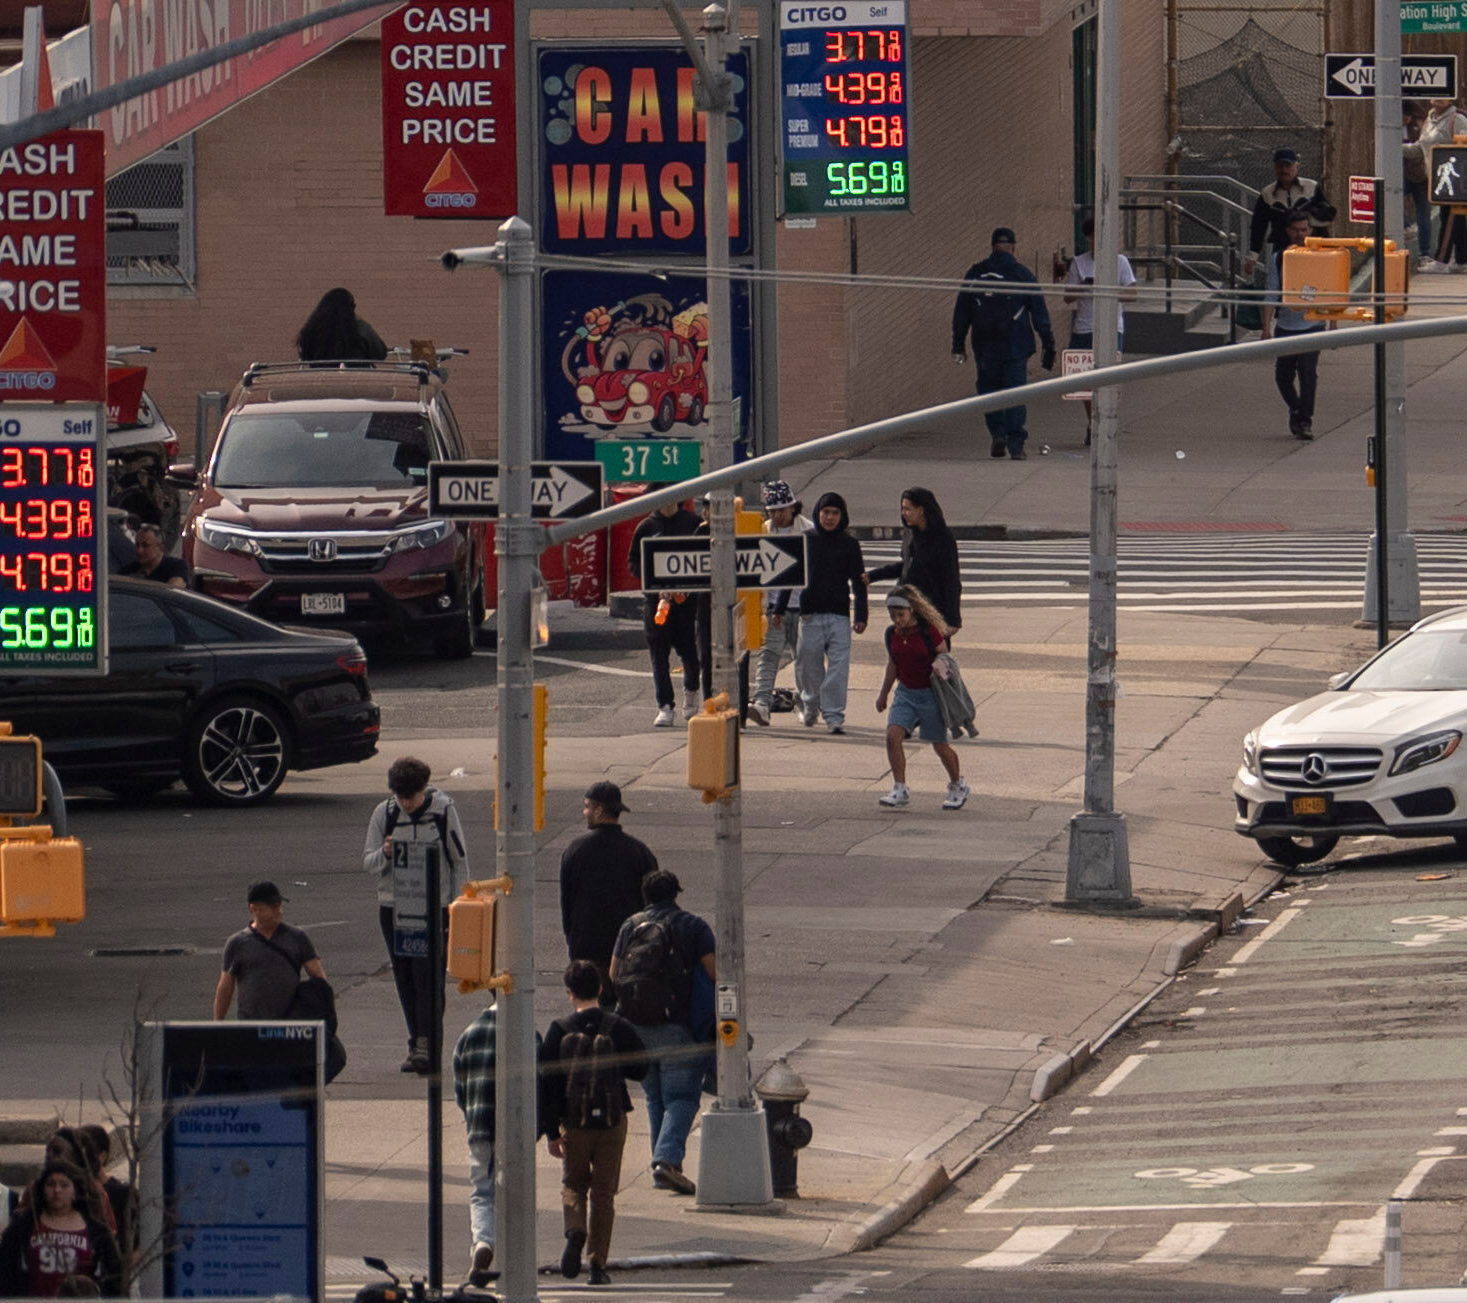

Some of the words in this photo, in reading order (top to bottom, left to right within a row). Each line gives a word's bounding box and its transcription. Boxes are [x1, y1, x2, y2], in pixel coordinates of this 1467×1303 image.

[403, 7, 491, 34] CASH
[786, 6, 848, 24] CITGO
[868, 6, 888, 19] Self
[1431, 3, 1458, 23] High
[1422, 21, 1461, 32] Boulevard
[389, 43, 507, 72] CREDIT
[1345, 67, 1375, 85] ONE
[1401, 68, 1439, 85] WAY
[404, 81, 493, 107] SAME
[401, 118, 496, 145] PRICE
[424, 192, 477, 208] CITGO
[824, 197, 842, 207] ALL
[843, 197, 869, 206] TAXES
[870, 196, 906, 206] INCLUDED
[63, 418, 93, 438] Self
[2, 447, 74, 490] 3.77
[621, 445, 651, 478] 37
[662, 443, 680, 466] St
[447, 478, 495, 503] ONE
[530, 478, 568, 503] AY
[0, 499, 74, 541] 4.39
[665, 554, 712, 576] ONE
[734, 551, 781, 574] WAY
[0, 607, 74, 649] 5.69
[257, 1025, 314, 1039] LinkNYC
[178, 1105, 239, 1125] Nearby
[178, 1119, 262, 1136] Bikeshare
[29, 1230, 88, 1252] CALIFORNIA
